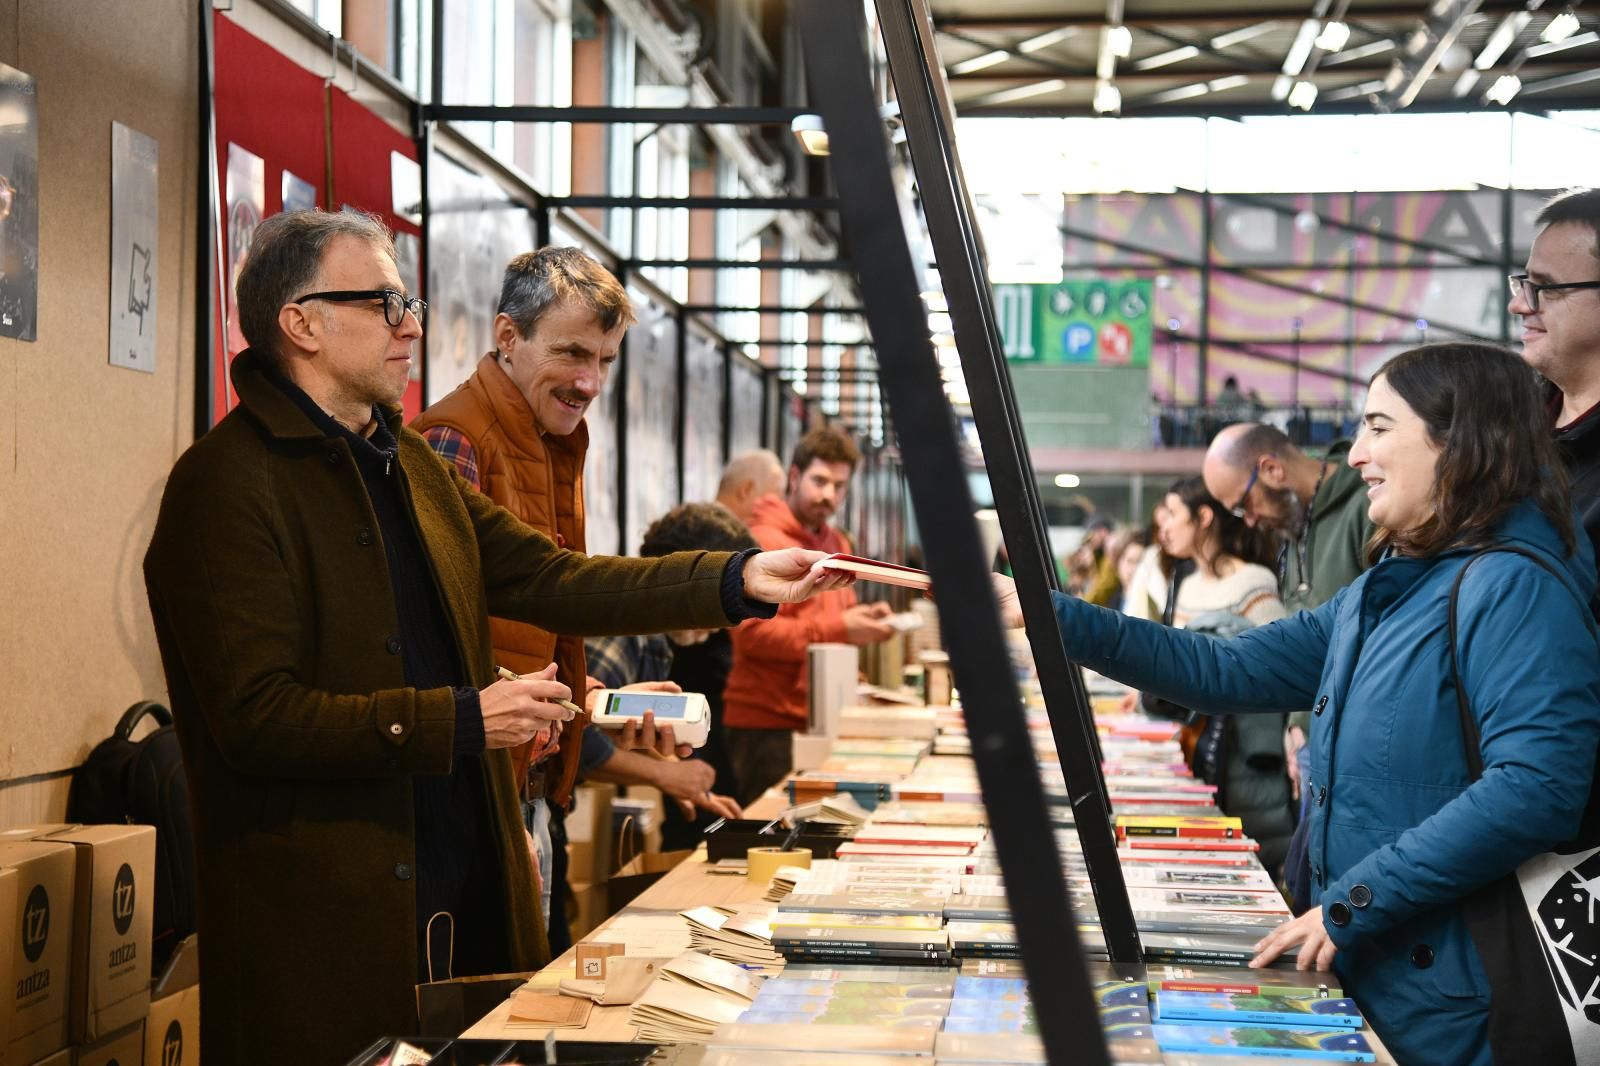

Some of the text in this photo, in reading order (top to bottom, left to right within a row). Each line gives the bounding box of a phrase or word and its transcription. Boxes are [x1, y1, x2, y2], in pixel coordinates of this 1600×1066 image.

[114, 880, 133, 919] tz
[26, 904, 47, 945] tz
[108, 941, 137, 969] antza
[16, 968, 50, 1000] antza
